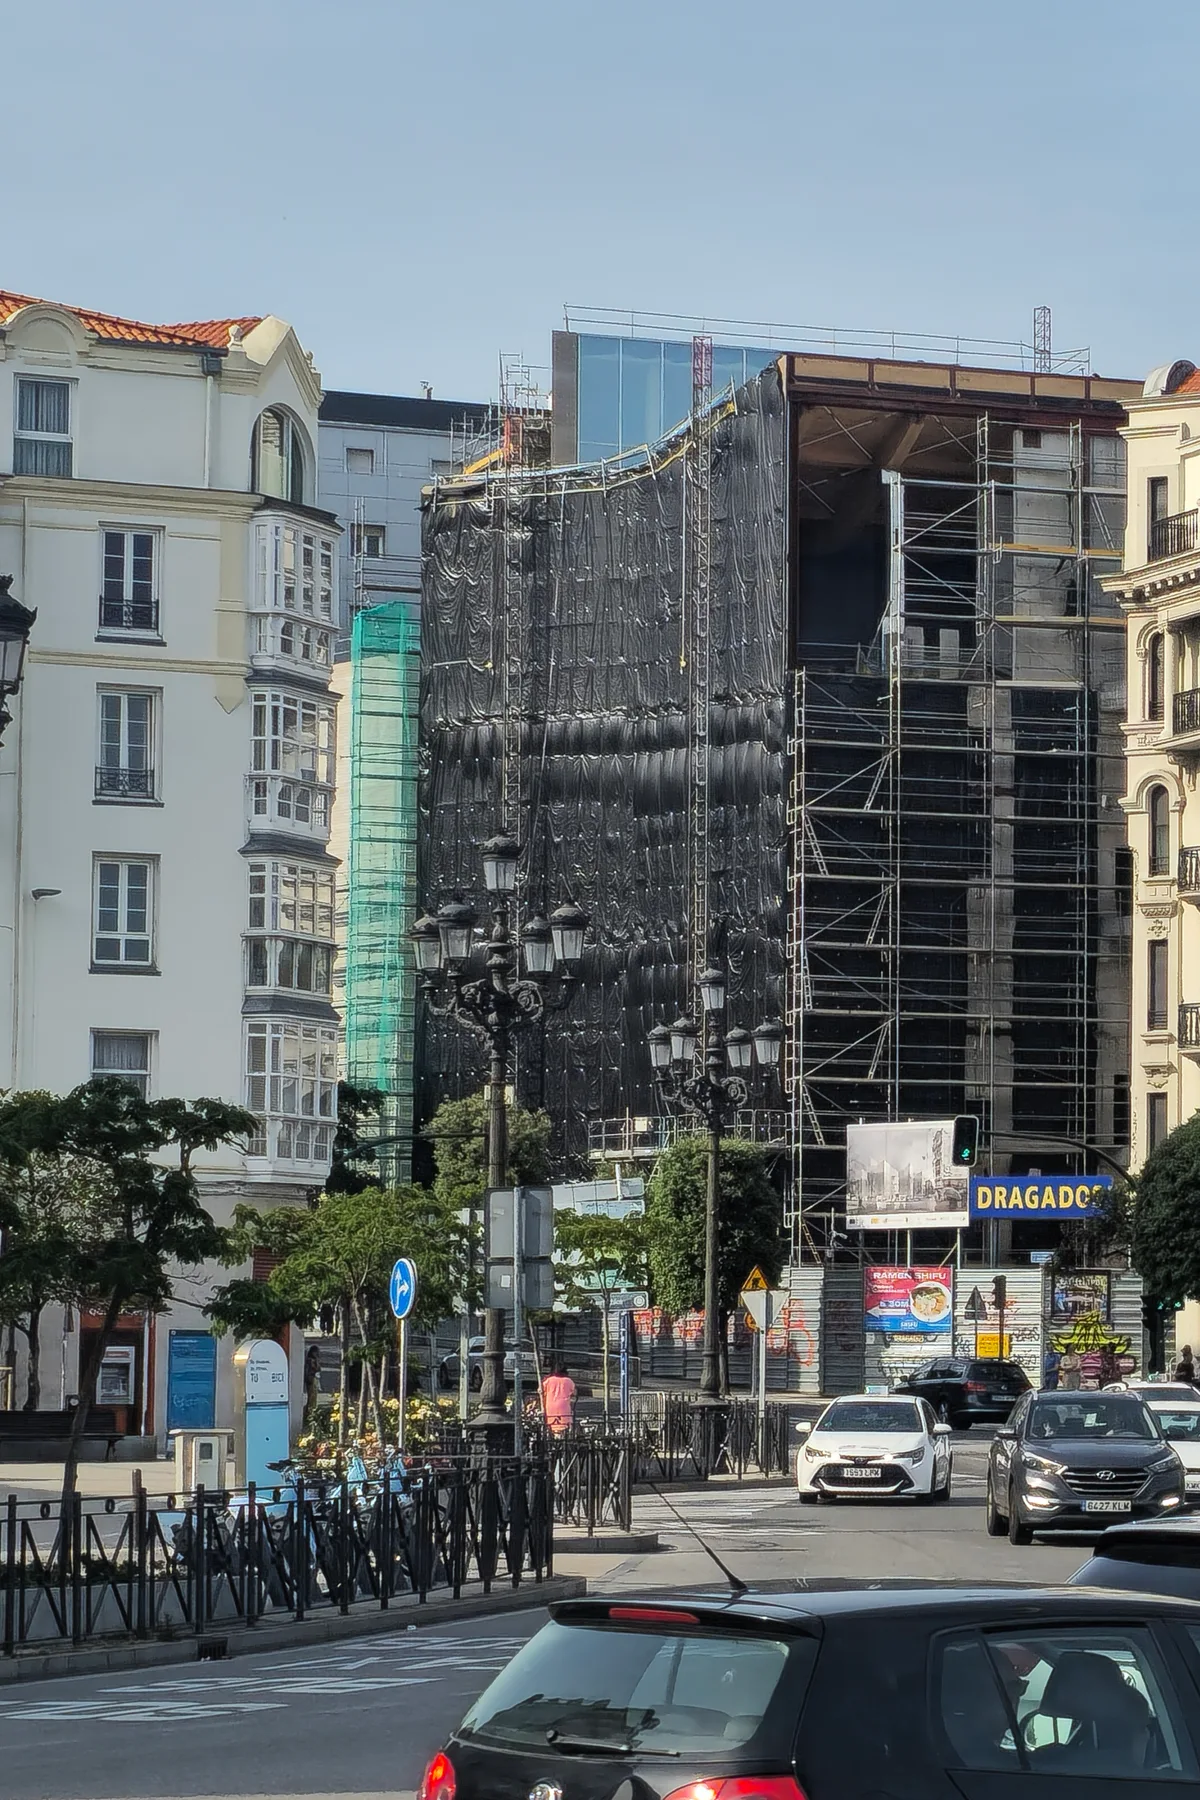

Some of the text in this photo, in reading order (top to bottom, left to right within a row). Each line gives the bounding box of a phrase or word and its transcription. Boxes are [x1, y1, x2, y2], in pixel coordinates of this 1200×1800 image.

[873, 1272, 946, 1280] RAMEN SHIFU
[0, 1700, 292, 1722] SOL
